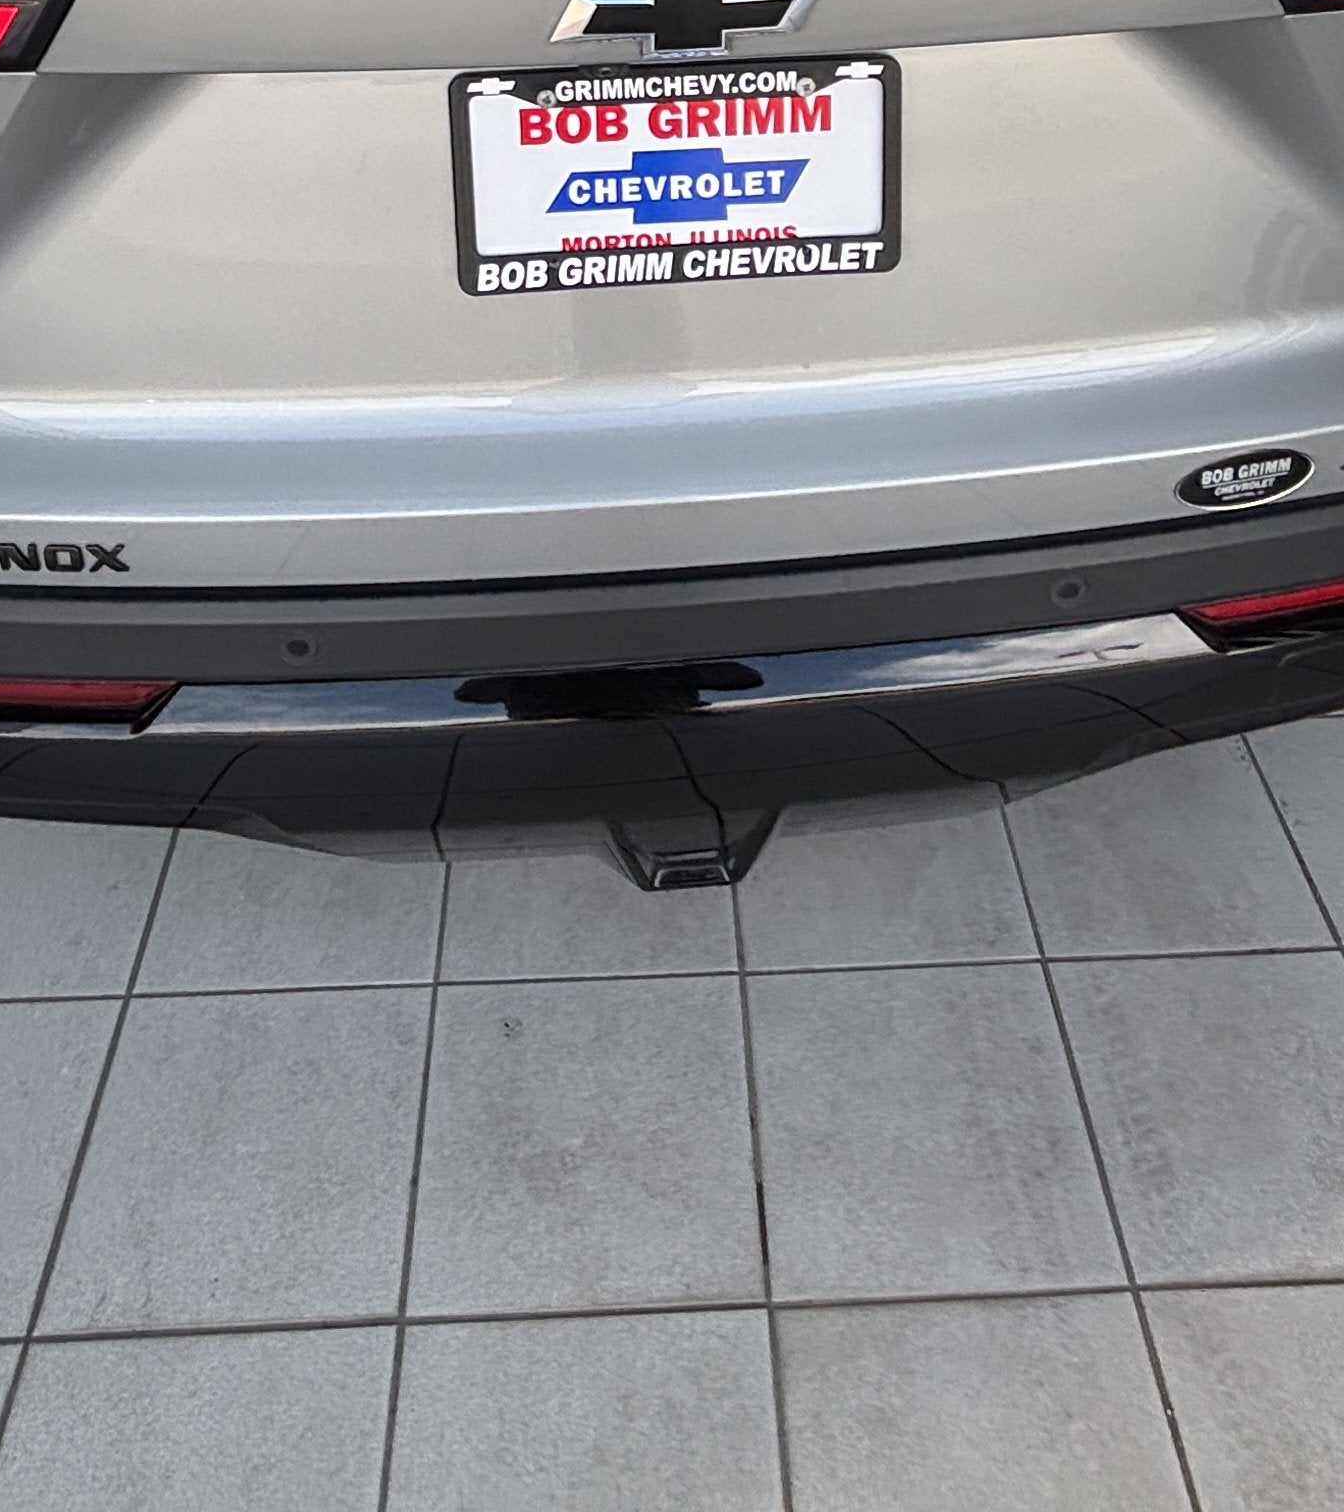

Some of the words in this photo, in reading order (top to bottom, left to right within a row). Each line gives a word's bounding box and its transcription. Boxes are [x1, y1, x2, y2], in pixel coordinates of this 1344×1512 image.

[555, 71, 798, 102] GRIMMCHEVY.COM
[518, 104, 628, 145] BOB
[647, 95, 832, 139] GRIMM
[567, 169, 786, 205] CHEVROLET
[561, 231, 673, 253] MORTON
[476, 261, 549, 292] BOB
[558, 250, 674, 286] GRIMM
[681, 242, 885, 279] CHEVROLET
[1201, 466, 1234, 485] BOB
[1238, 457, 1292, 479] GRIMM
[1213, 477, 1276, 497] CHEVROLET
